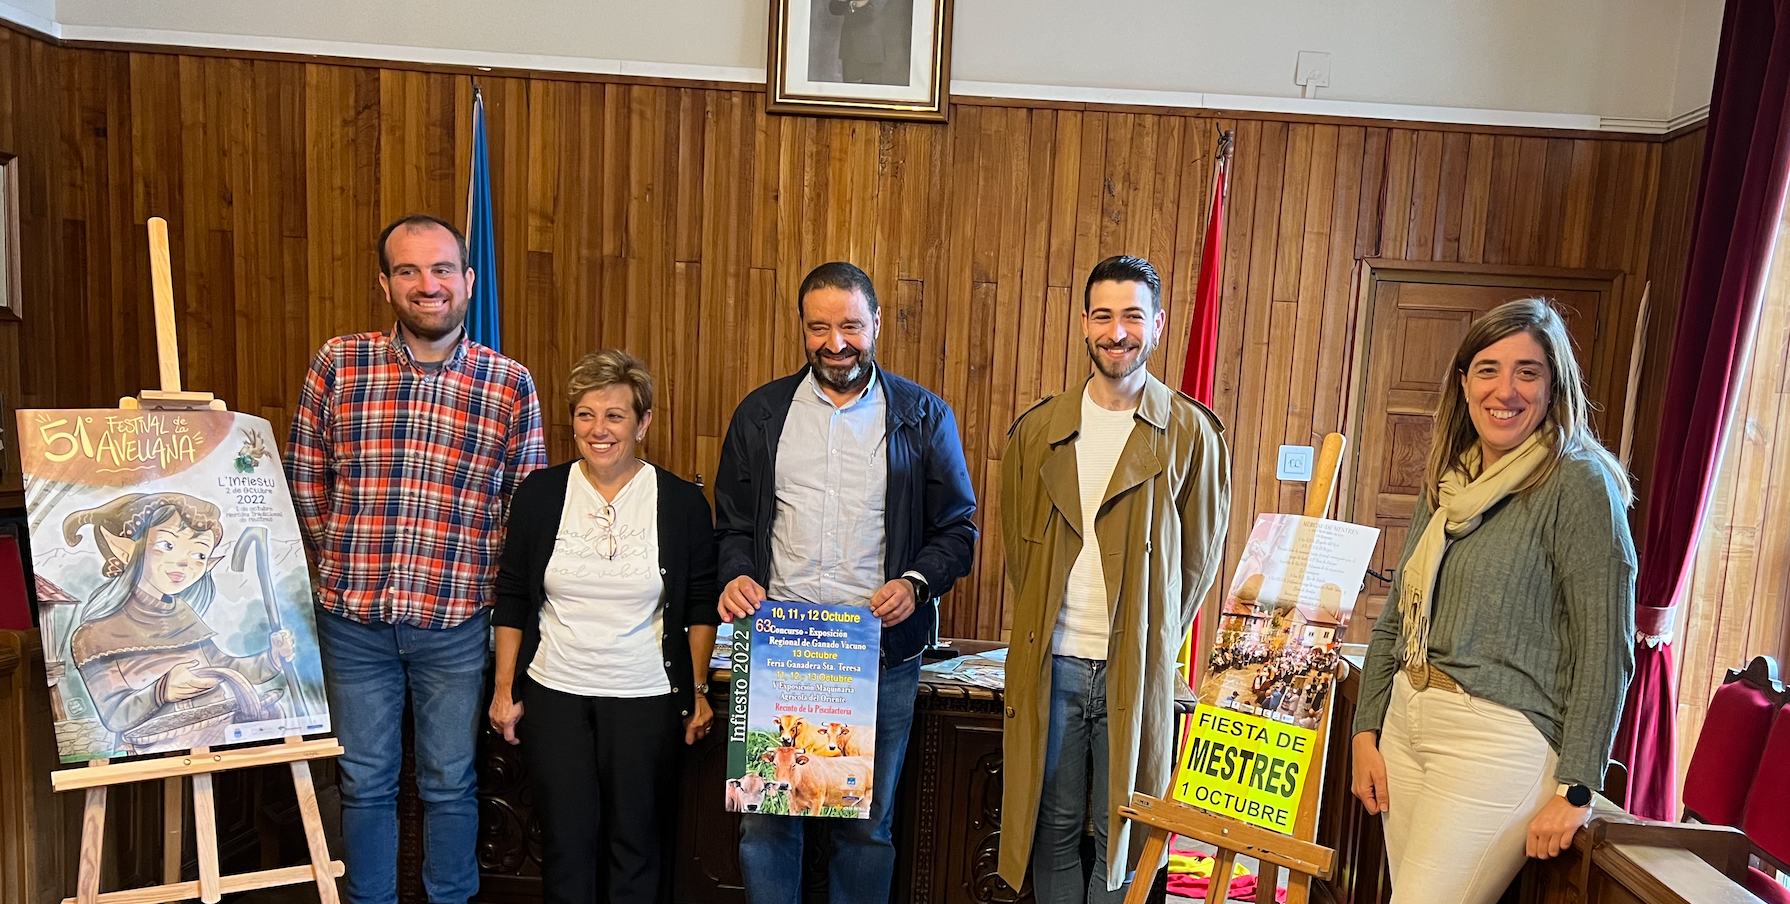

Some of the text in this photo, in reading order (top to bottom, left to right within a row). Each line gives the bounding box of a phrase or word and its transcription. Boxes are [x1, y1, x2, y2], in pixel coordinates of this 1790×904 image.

[96, 430, 196, 469] AVELLANA
[236, 494, 266, 504] 2022
[558, 527, 597, 541] ood
[598, 563, 652, 579] vibes
[771, 607, 861, 624] 10, 11 y 12 Octubre
[808, 627, 848, 640] Exposición
[769, 636, 867, 651] Regional de Ganado Vacuno
[792, 649, 838, 660] 13 Octubre
[766, 658, 861, 672] Feria Ganadera Sta. Teresa
[776, 670, 788, 680] 11,
[790, 671, 799, 680] 12
[807, 672, 817, 681] 13
[819, 672, 853, 683] Octubre
[730, 629, 750, 743] Infiesto 2022
[778, 681, 815, 692] Exposición
[815, 684, 855, 695] Maquinaria
[808, 694, 819, 702] del
[820, 695, 846, 703] Oriente
[775, 702, 798, 712] Recinto
[798, 704, 807, 713] de
[807, 704, 813, 713] la
[1199, 712, 1307, 753] FIESTA DE
[1187, 737, 1299, 798] MESTRES
[1182, 781, 1289, 827] 1 OCTUBRE
